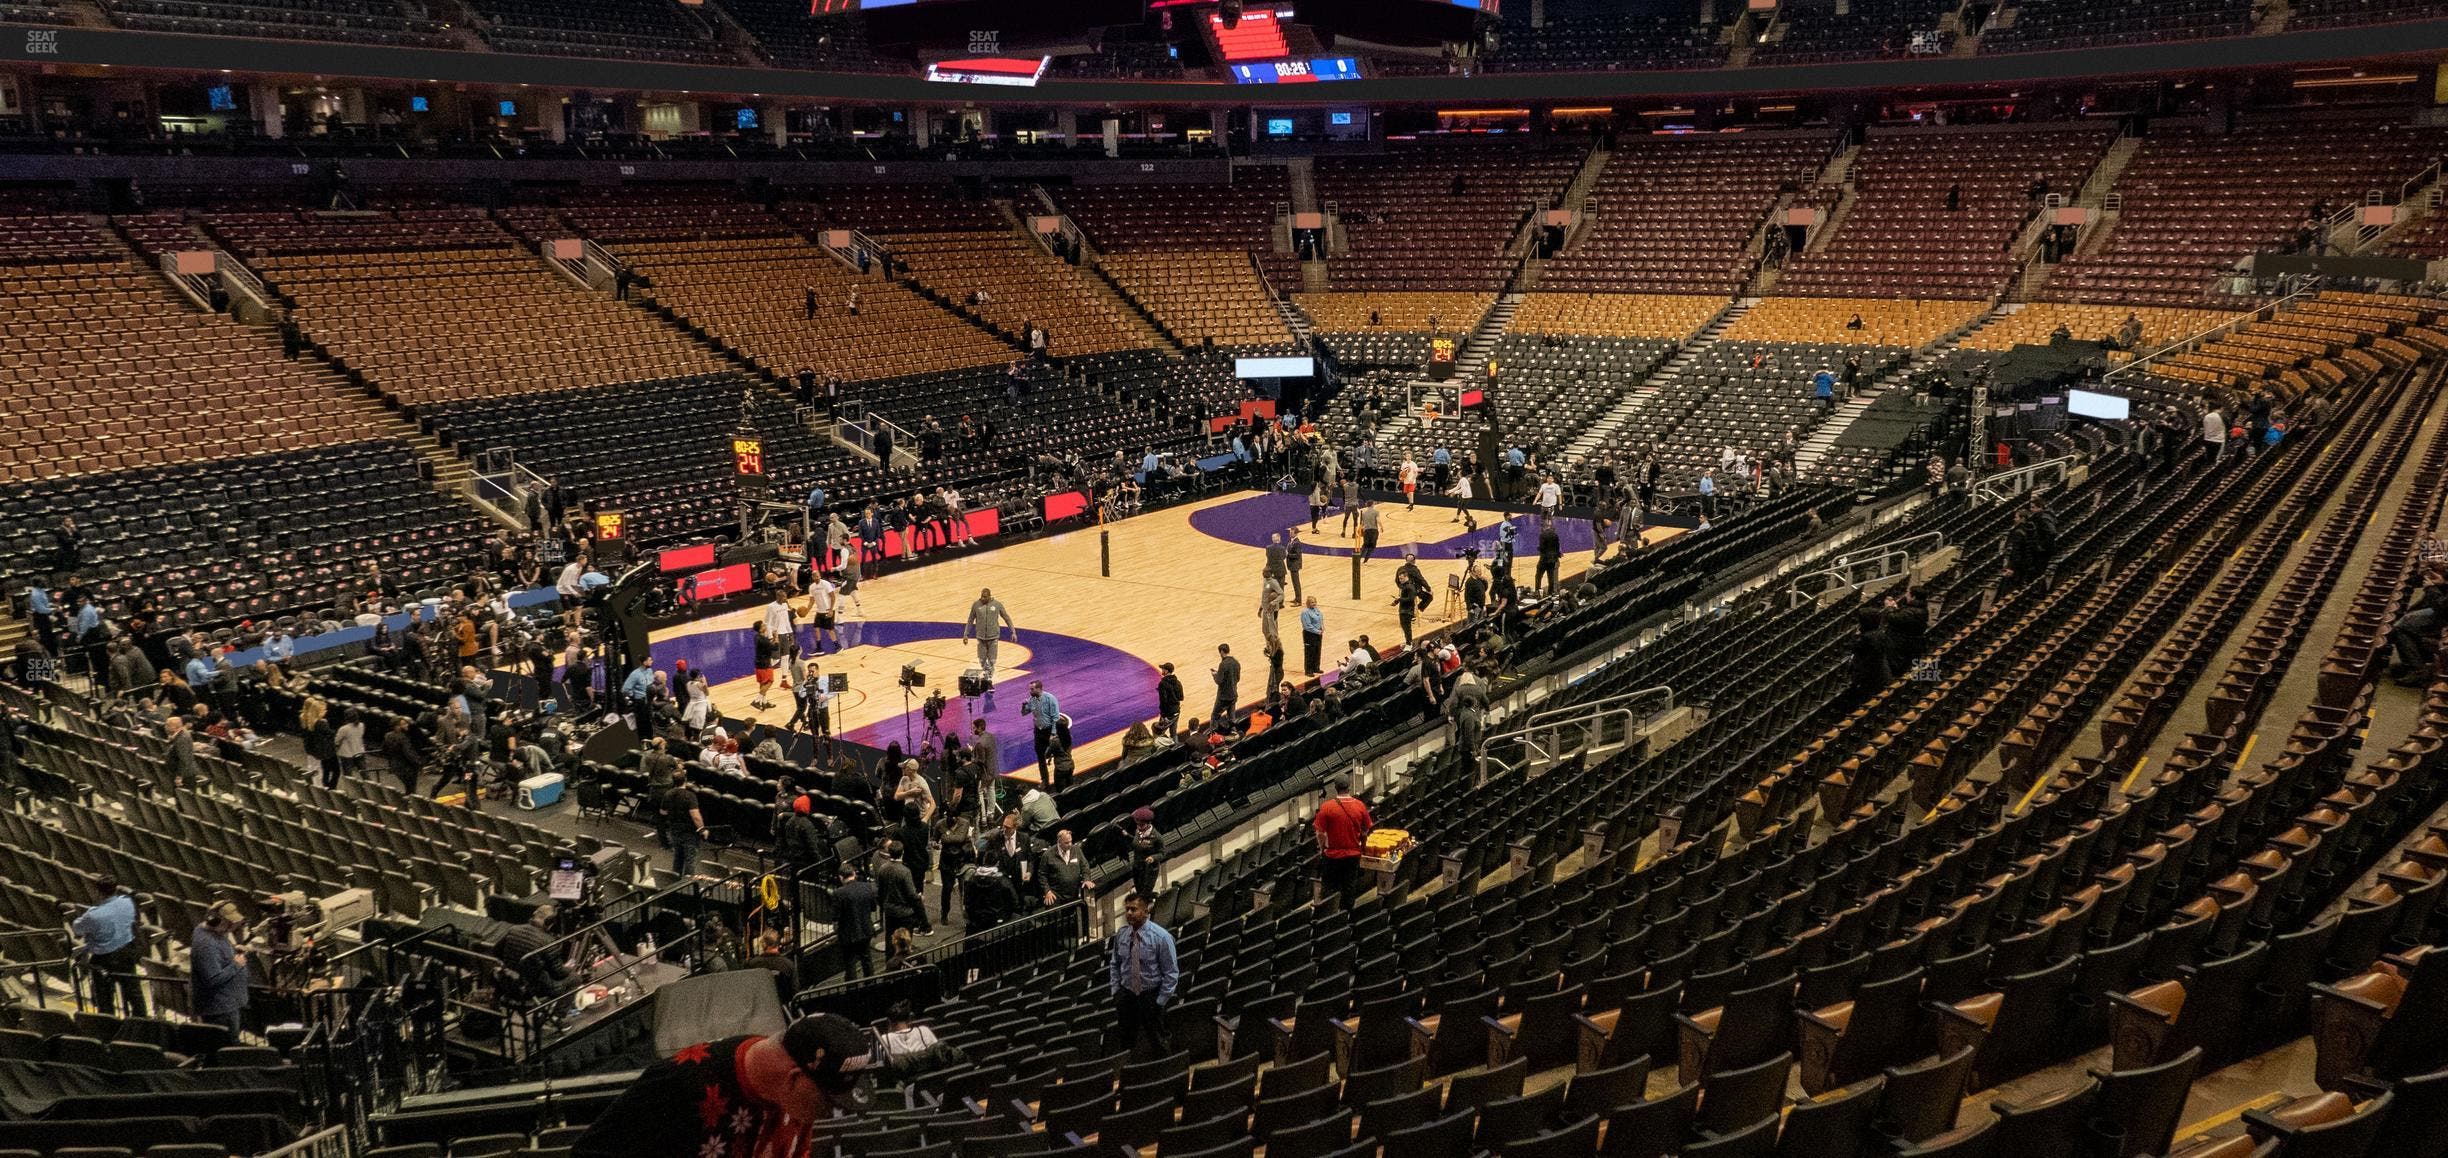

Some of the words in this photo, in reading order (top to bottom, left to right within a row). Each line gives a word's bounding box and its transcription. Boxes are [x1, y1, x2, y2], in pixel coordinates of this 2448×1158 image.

[620, 166, 635, 175] 120
[874, 165, 886, 174] 121
[1435, 348, 1451, 361] 24
[739, 453, 760, 473] 24
[602, 525, 618, 539] 24
